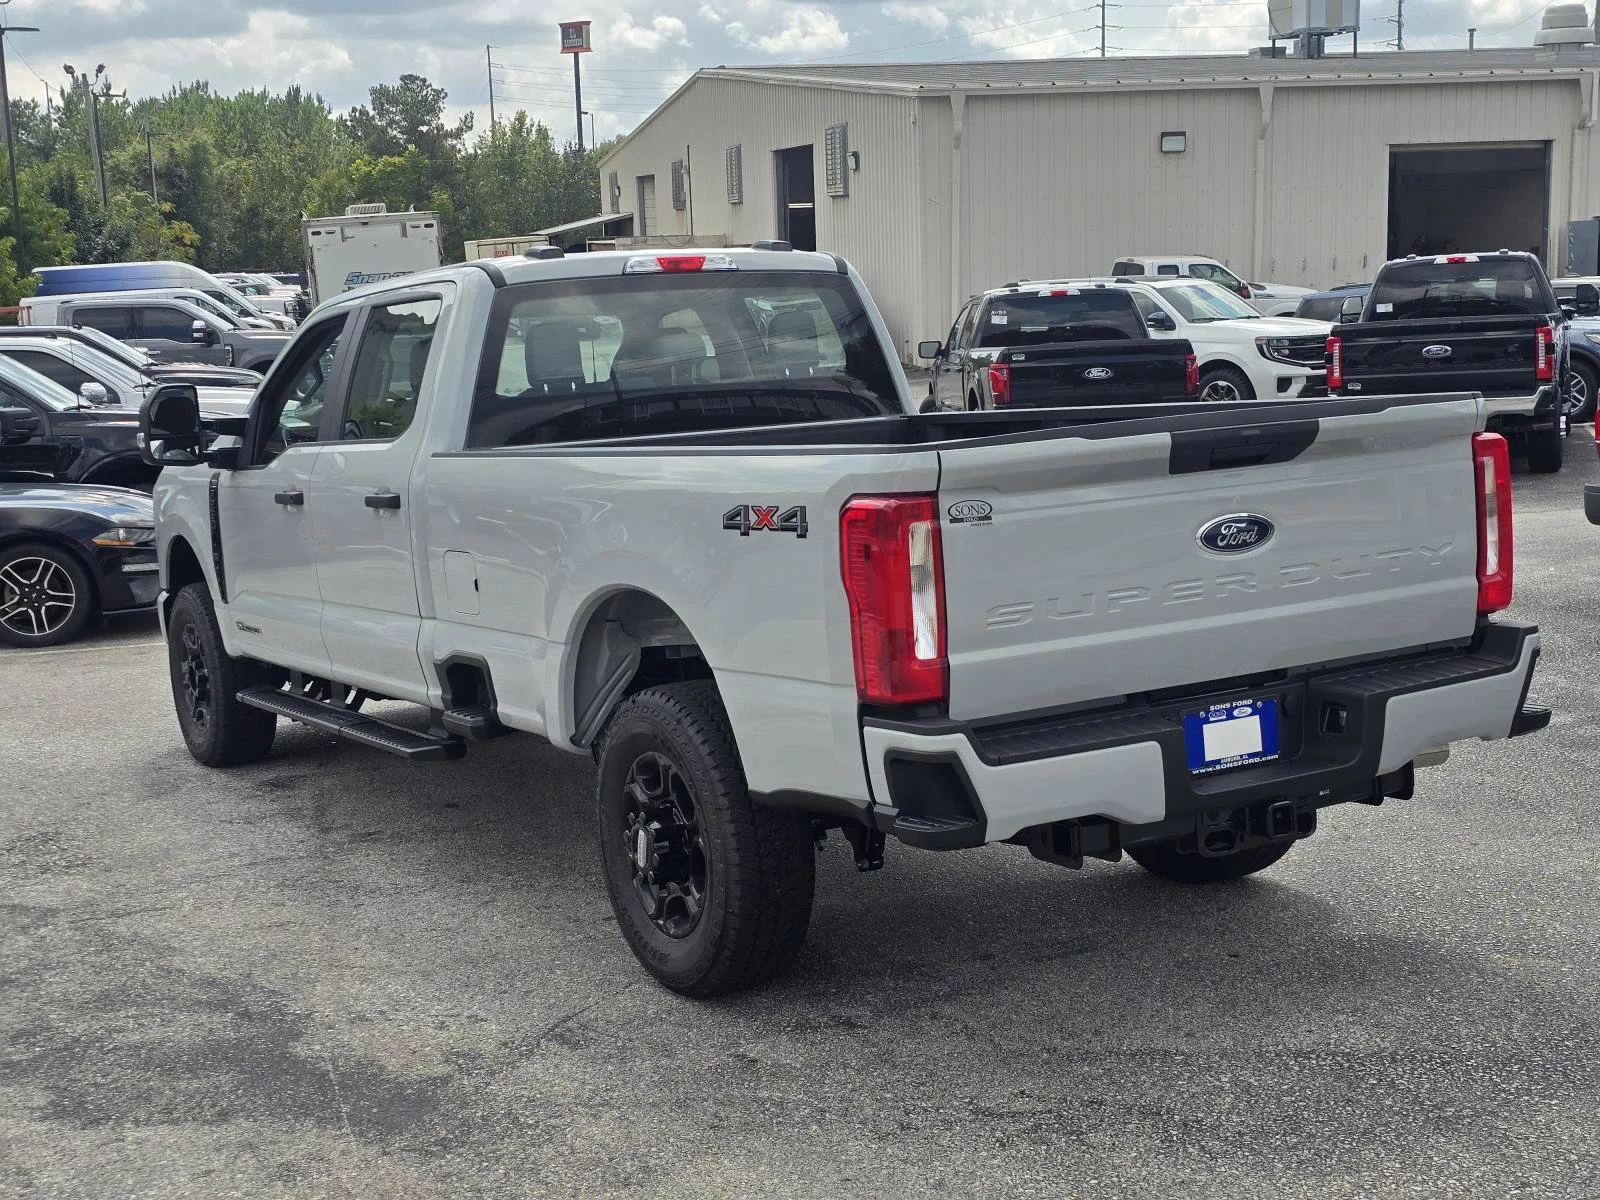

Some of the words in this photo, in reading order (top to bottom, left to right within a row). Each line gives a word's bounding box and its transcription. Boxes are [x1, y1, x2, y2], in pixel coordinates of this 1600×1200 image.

[344, 271, 415, 286] Snap-
[1087, 368, 1109, 378] Ford
[954, 503, 986, 516] SONS
[1216, 521, 1259, 547] Ford
[985, 571, 1257, 630] SUPER
[1279, 541, 1454, 589] DUTY
[1209, 702, 1231, 711] SONS
[1232, 699, 1253, 707] FORD
[1191, 754, 1279, 774] www.SONSFORD.com
